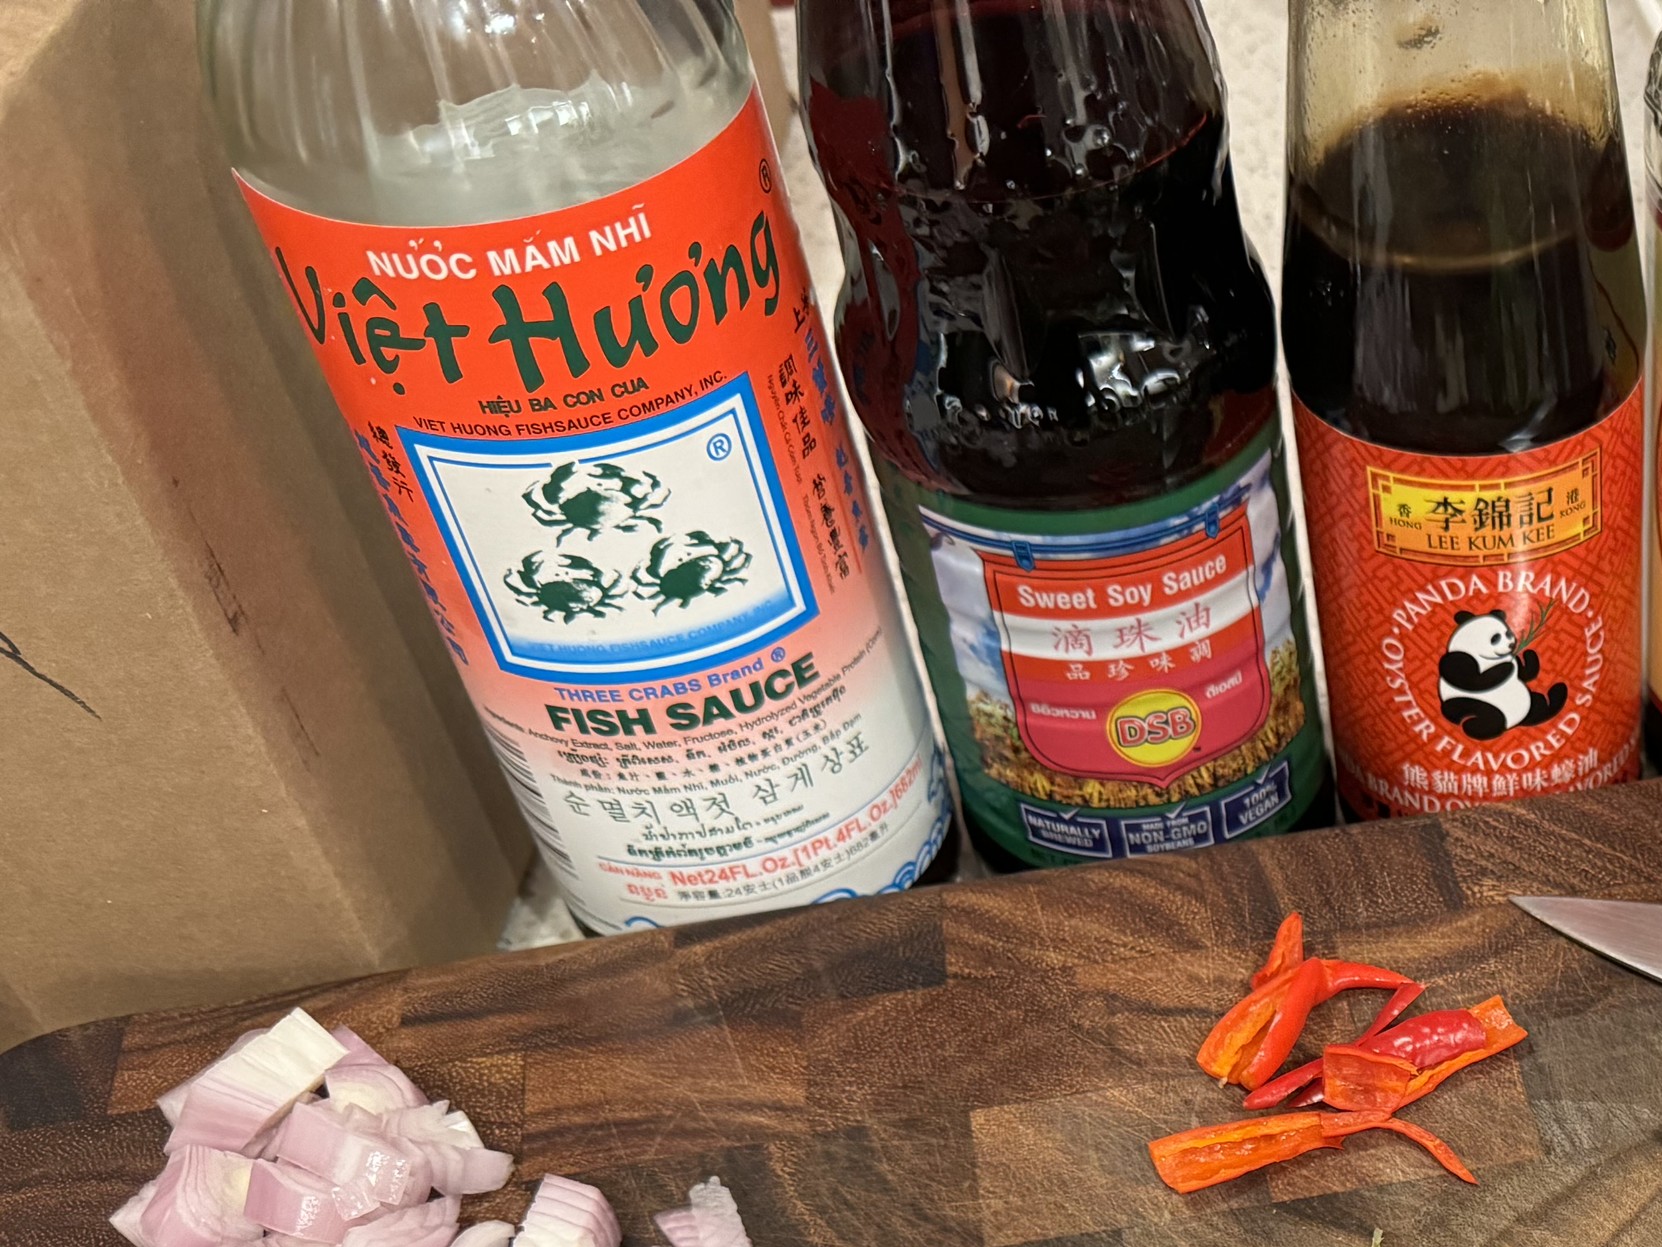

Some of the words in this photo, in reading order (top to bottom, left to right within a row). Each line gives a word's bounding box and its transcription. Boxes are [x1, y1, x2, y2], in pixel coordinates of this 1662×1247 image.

[486, 229, 581, 276] MẮM
[589, 203, 652, 256] NHĨ
[275, 246, 470, 395] Việt
[488, 210, 780, 393] Hương
[413, 416, 446, 433] VIET
[450, 422, 511, 437] HUONG
[516, 412, 612, 436] FISHSAUCE
[617, 384, 699, 420] COMPANY,
[699, 370, 727, 393] INC.
[530, 398, 558, 412] BA
[563, 389, 604, 408] CON
[611, 377, 649, 398] CUA
[1389, 516, 1422, 531] HONG
[1397, 503, 1412, 519] 香
[1425, 486, 1555, 532] 李錦記
[1559, 501, 1586, 520] KONG
[1427, 533, 1460, 551] LEE
[1468, 534, 1515, 551] KUM
[1522, 525, 1555, 544] KEE
[1017, 584, 1097, 610] Sweet
[1107, 583, 1152, 607] Soy
[1162, 554, 1226, 595] Sauce
[1050, 602, 1212, 657] 滴珠油
[544, 703, 657, 738] FISH
[665, 652, 821, 733] SAUCE
[554, 687, 622, 703] THREE
[629, 674, 702, 701] CRABS
[707, 657, 765, 688] Brand
[1382, 637, 1436, 742] OYSTER
[1434, 711, 1581, 772] FLAVORED
[1575, 616, 1605, 708] SAUCE
[642, 738, 683, 752] Water,
[739, 701, 798, 733] Hydrolyzed
[1117, 707, 1195, 748] DSB
[563, 790, 590, 817] 순
[597, 799, 661, 825] 멸치
[670, 791, 736, 822] 액젓
[752, 778, 781, 806] 삼
[787, 763, 814, 793] 게
[1238, 795, 1280, 825] VEGAN
[1028, 814, 1101, 839] NATURALLY
[1128, 821, 1208, 846] NON-GMO
[1147, 838, 1194, 853] SOYBEANS
